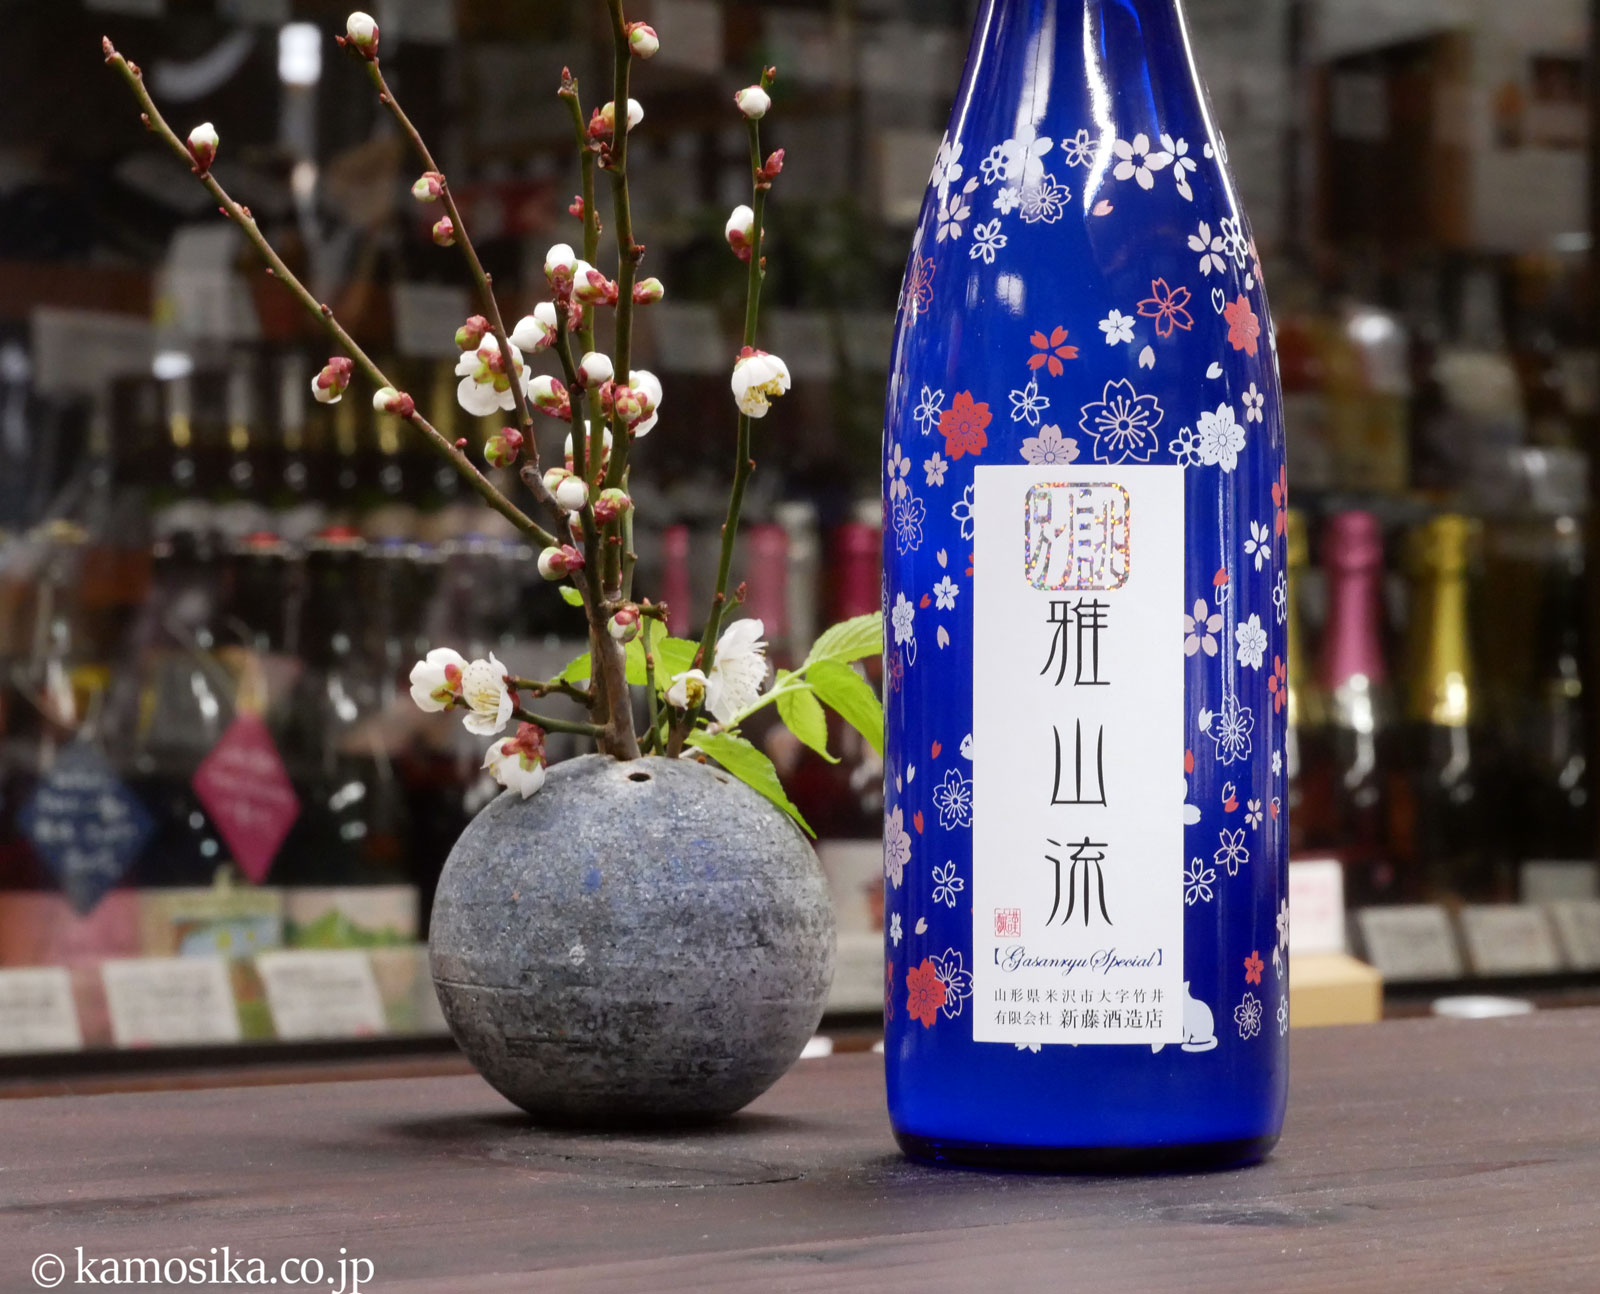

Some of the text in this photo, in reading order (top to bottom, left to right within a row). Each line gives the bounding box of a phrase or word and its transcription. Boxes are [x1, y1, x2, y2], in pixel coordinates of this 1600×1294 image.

[1040, 597, 1112, 926] 雅山流
[994, 988, 1164, 1004] 山形県米沢市大字竹井
[994, 1008, 1163, 1030] 有限会社 新藤酒造店
